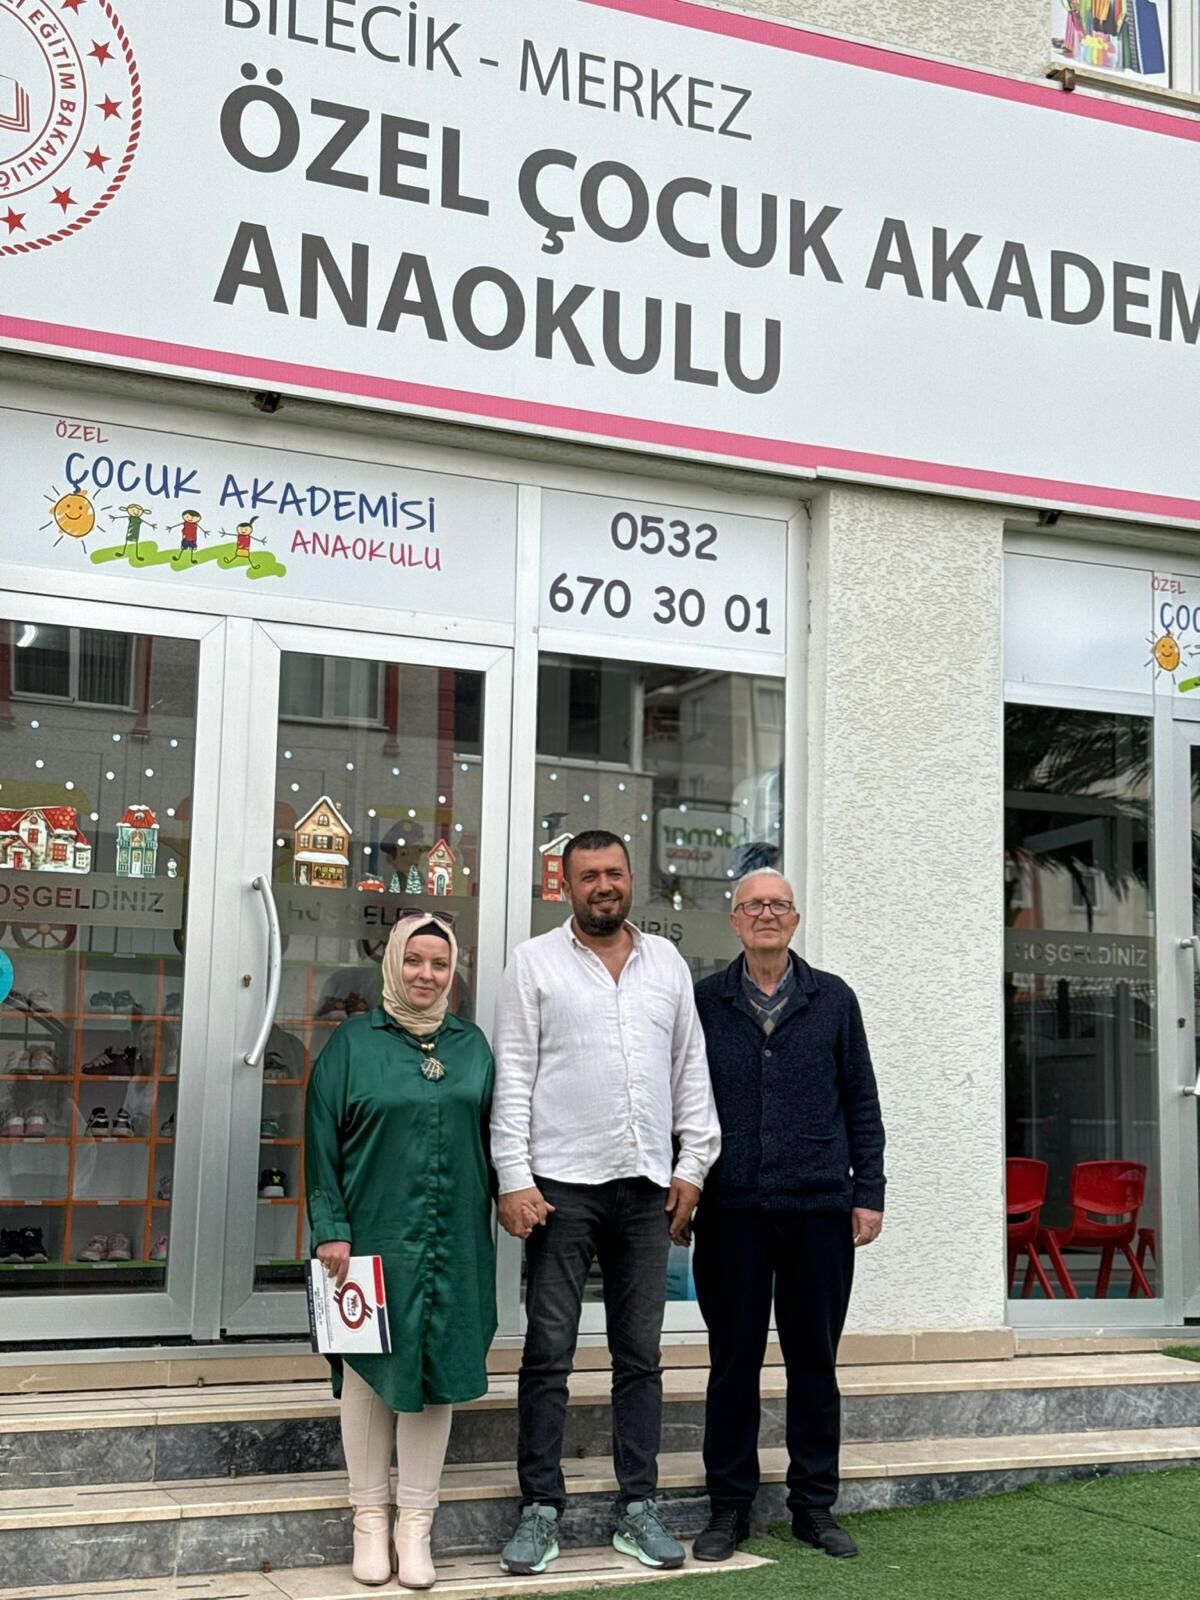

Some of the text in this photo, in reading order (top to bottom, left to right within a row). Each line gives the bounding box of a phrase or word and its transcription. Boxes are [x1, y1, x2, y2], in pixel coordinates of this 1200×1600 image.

[519, 39, 752, 140] MERKEZ
[220, 62, 1200, 345] ÖZEL ÇOCUK AKADEM
[213, 221, 781, 394] ANAOKULU
[55, 420, 108, 444] ÖZEL
[65, 452, 435, 533] ÇOCUK AKADEMİSİ
[290, 529, 441, 571] ANAOKULU
[611, 511, 717, 561] 0532
[549, 572, 771, 635] 670 30 01
[634, 915, 683, 946] İRİŞ
